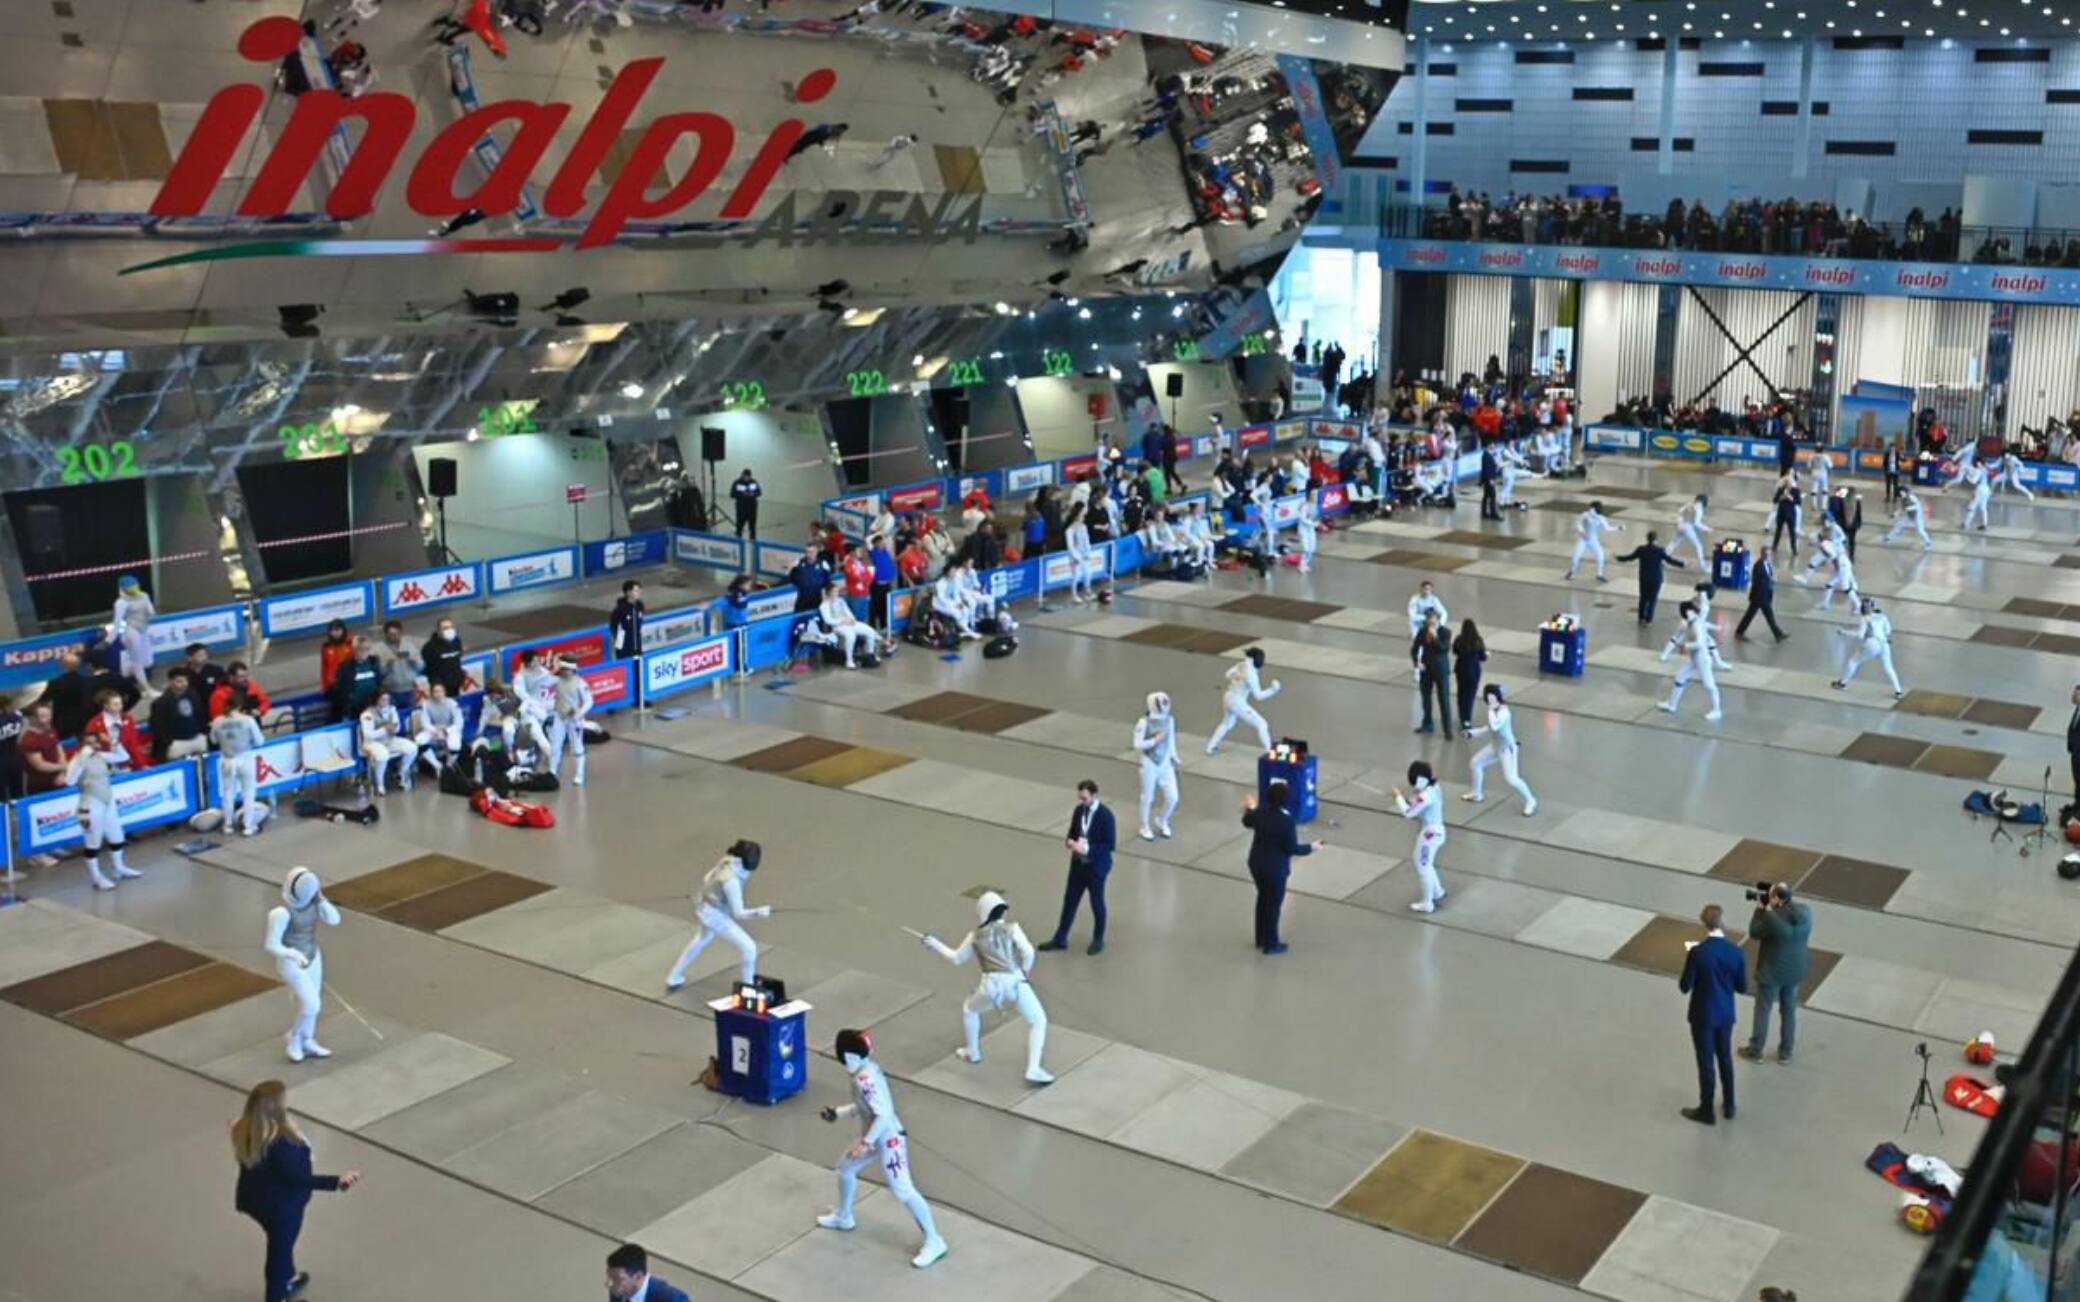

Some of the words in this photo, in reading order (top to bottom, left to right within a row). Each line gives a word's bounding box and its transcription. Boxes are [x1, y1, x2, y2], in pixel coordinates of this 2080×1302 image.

[152, 17, 836, 249] inalpi
[741, 188, 984, 249] ARENA
[1479, 248, 1522, 267] inalpi
[1554, 252, 1600, 273] inalpi
[1635, 256, 1682, 276] inalpi
[1718, 260, 1767, 280] inalpi
[1806, 263, 1857, 285] inalpi
[1897, 267, 1950, 288] inalpi
[1991, 271, 2047, 293] inalpi
[847, 371, 887, 396] 222
[56, 440, 139, 484] 202
[4, 642, 85, 666] Kappa
[654, 661, 677, 680] sky
[683, 646, 722, 673] sport
[738, 1048, 746, 1062] 2
